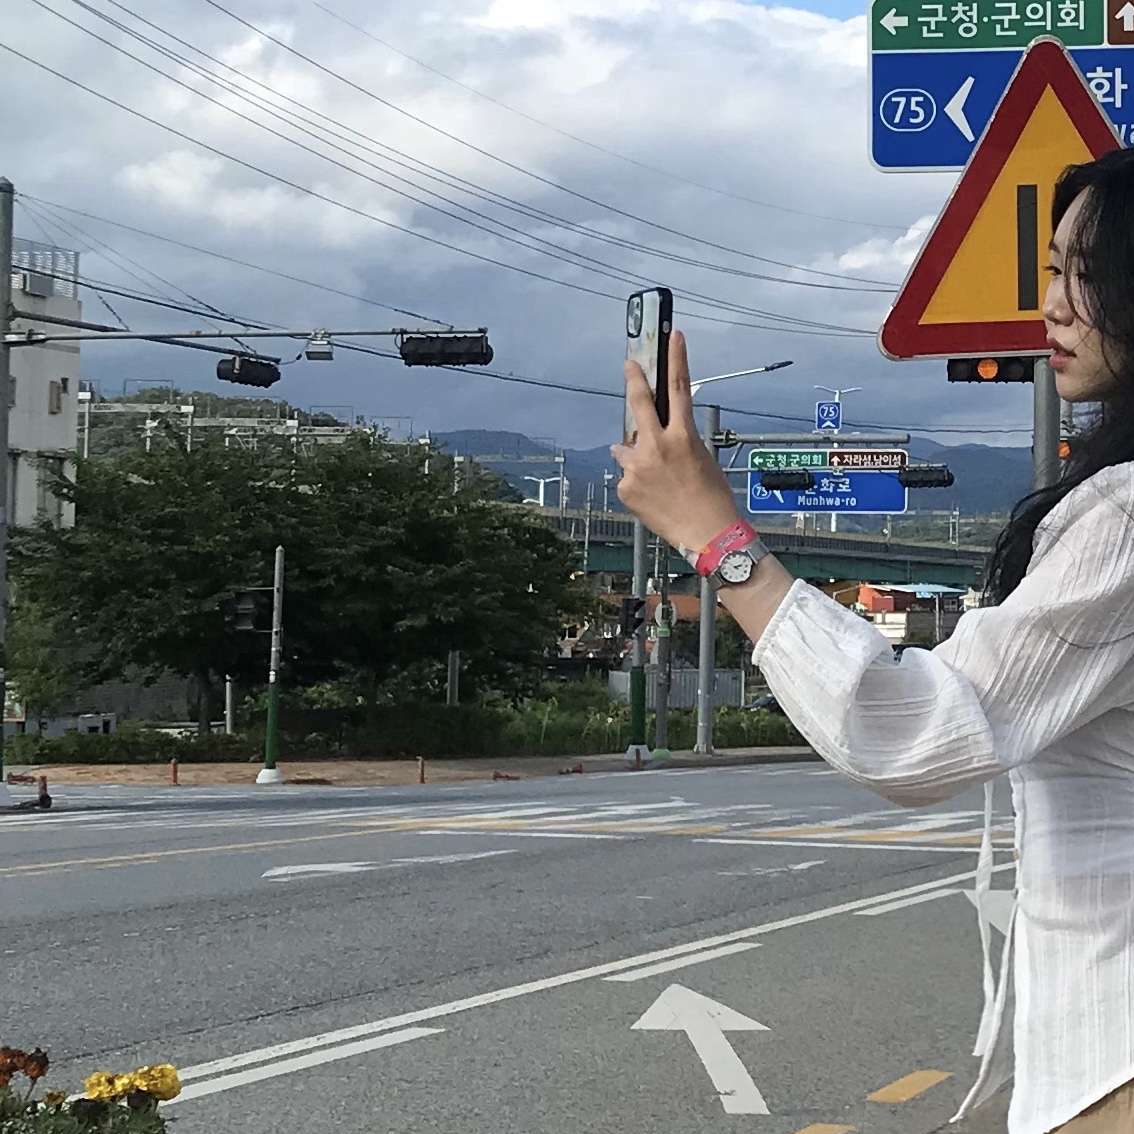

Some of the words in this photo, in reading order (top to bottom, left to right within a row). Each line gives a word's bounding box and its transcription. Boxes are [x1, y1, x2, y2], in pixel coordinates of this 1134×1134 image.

[917, 0, 1086, 38] 군청·군의회
[890, 96, 926, 124] 75
[822, 405, 836, 418] 75
[797, 495, 857, 506] Munhwa-ro
